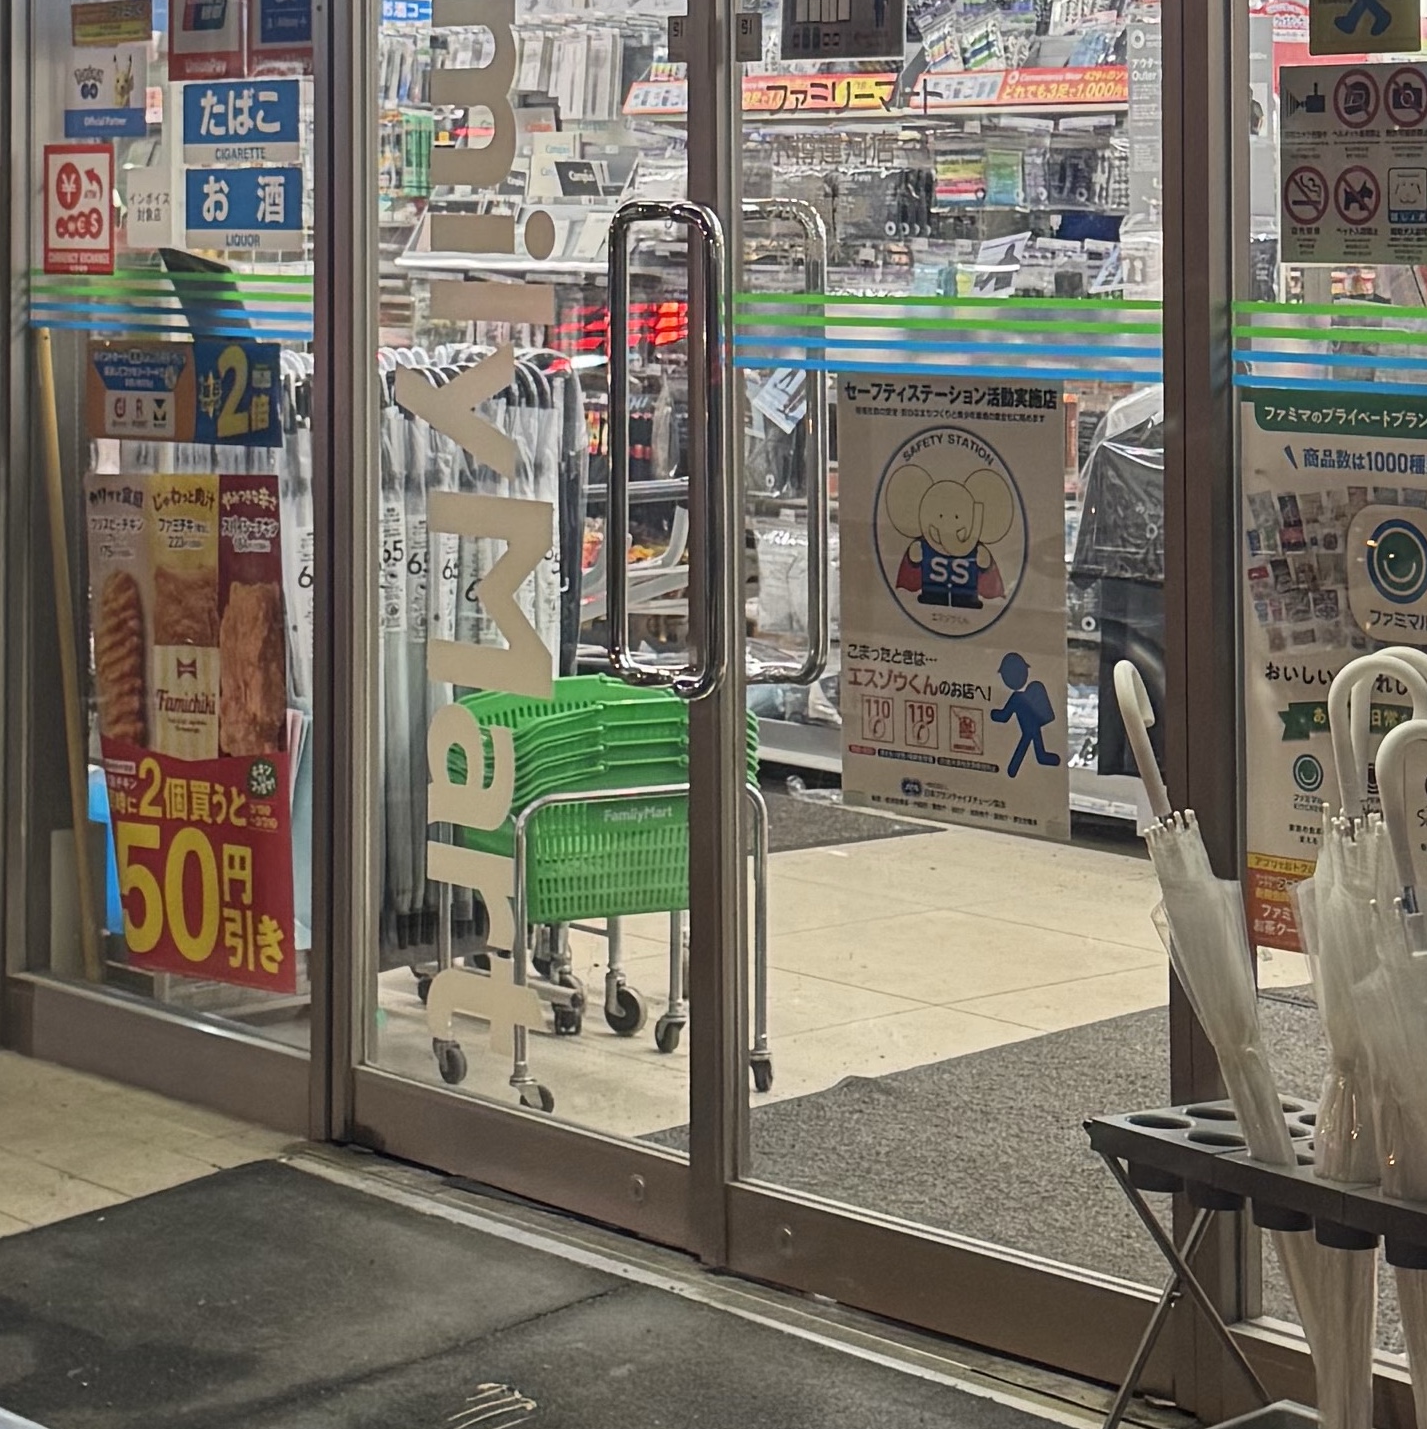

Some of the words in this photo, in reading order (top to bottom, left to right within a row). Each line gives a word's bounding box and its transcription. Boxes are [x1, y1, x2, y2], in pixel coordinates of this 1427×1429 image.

[766, 78, 944, 115] ファミリーマート
[200, 88, 281, 137] たばこ
[214, 147, 267, 160] CIGARETTE
[130, 191, 170, 206] インボイス
[202, 174, 286, 224] お酒
[137, 208, 162, 223] 対象店
[225, 233, 260, 247] LIQUOR
[845, 381, 1058, 411] セーフティステーション活動実施店
[903, 433, 945, 463] SAFETY
[947, 433, 995, 467] STATION
[929, 556, 971, 584] SS
[157, 689, 217, 716] Famichiki
[864, 698, 891, 720] 110
[907, 703, 936, 725] 119
[603, 805, 673, 824] FamilyMart
